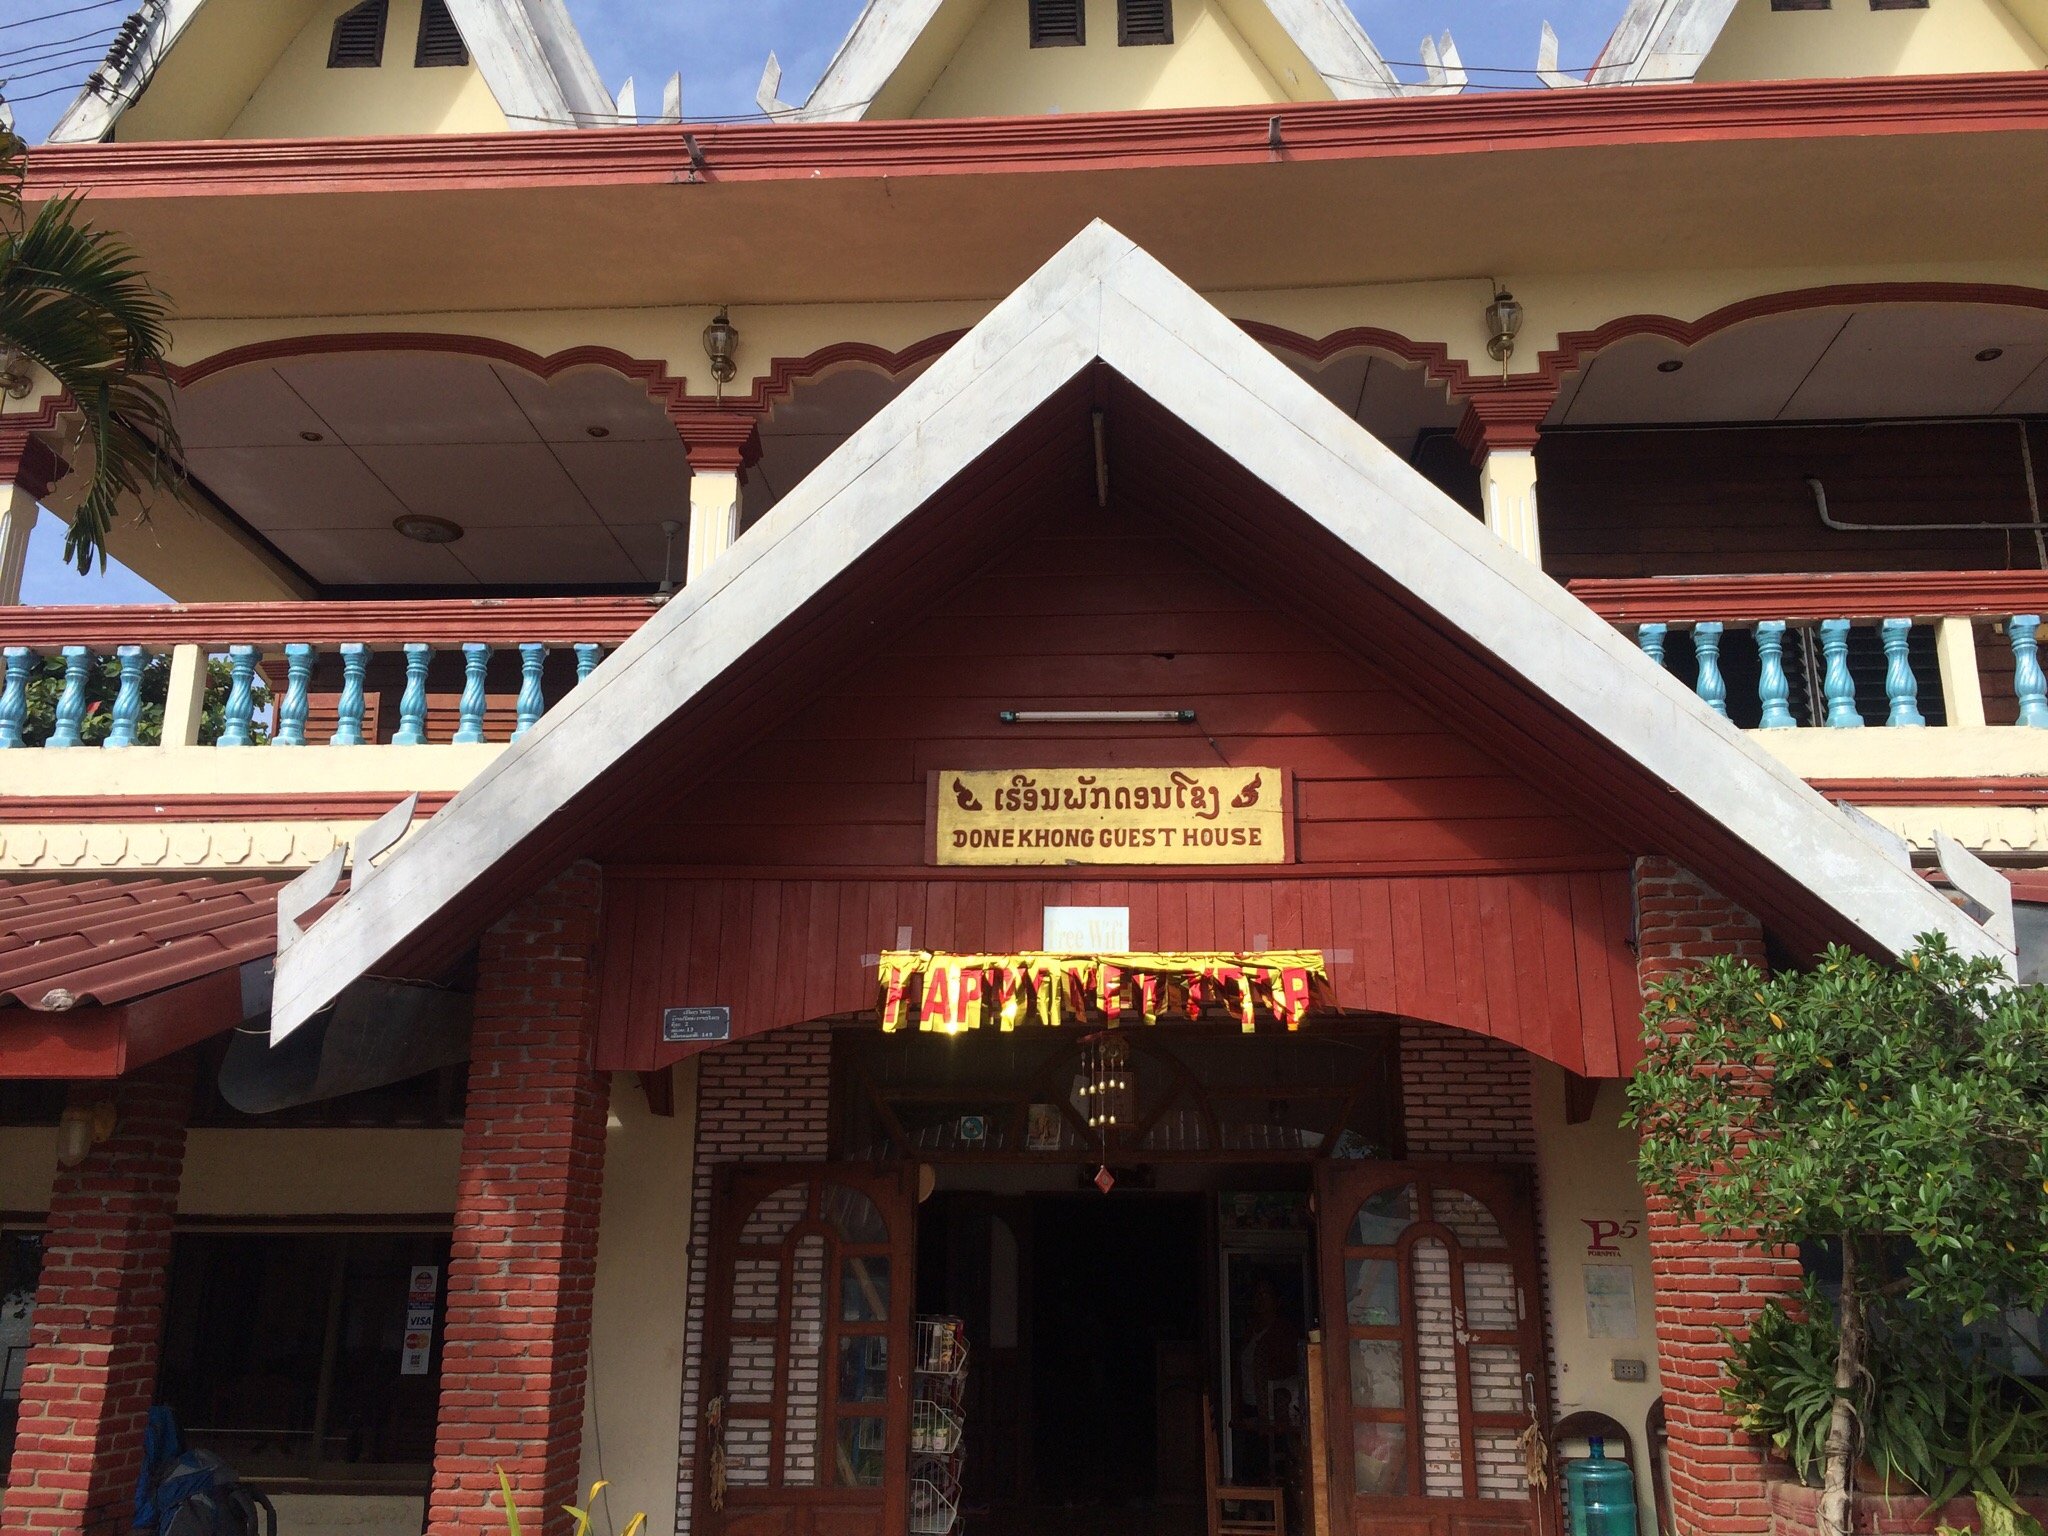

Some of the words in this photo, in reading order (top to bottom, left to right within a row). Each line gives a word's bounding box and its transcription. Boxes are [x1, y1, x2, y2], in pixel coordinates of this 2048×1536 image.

[1099, 827, 1177, 848] GUEST
[1182, 827, 1262, 847] HOUSE
[410, 1316, 432, 1326] VISA
